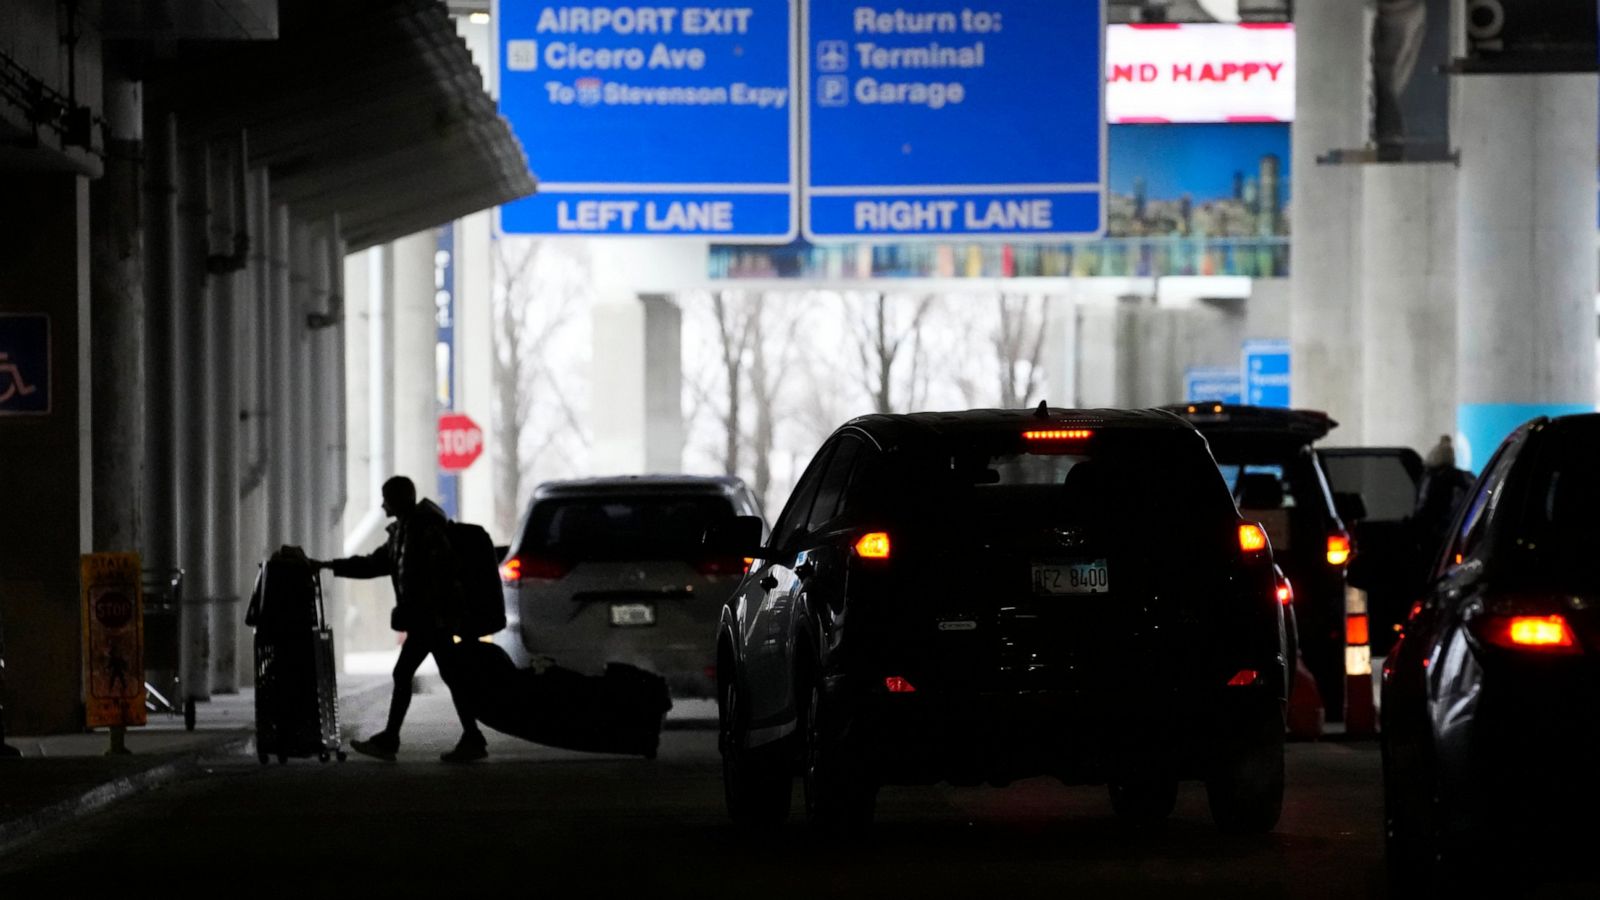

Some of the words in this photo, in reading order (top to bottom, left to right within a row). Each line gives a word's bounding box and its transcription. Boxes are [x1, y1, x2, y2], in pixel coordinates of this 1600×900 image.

[537, 7, 677, 34] AIRPORT
[682, 8, 753, 34] EXIT
[854, 7, 956, 33] Return
[961, 9, 1002, 32] to:
[544, 42, 645, 69] Cicero
[648, 43, 706, 69] Ave
[856, 42, 984, 69] Terminal
[1108, 63, 1158, 82] ND
[1172, 62, 1284, 82] HAPPY
[546, 81, 575, 104] To
[603, 82, 727, 104] Stevenson
[729, 83, 788, 108] Expy
[855, 77, 964, 108] Garage
[557, 201, 639, 230] LEFT
[645, 202, 733, 230] LANE
[855, 201, 957, 230] RIGHT
[965, 200, 1053, 229] LANE
[1070, 567, 1107, 588] 8400
